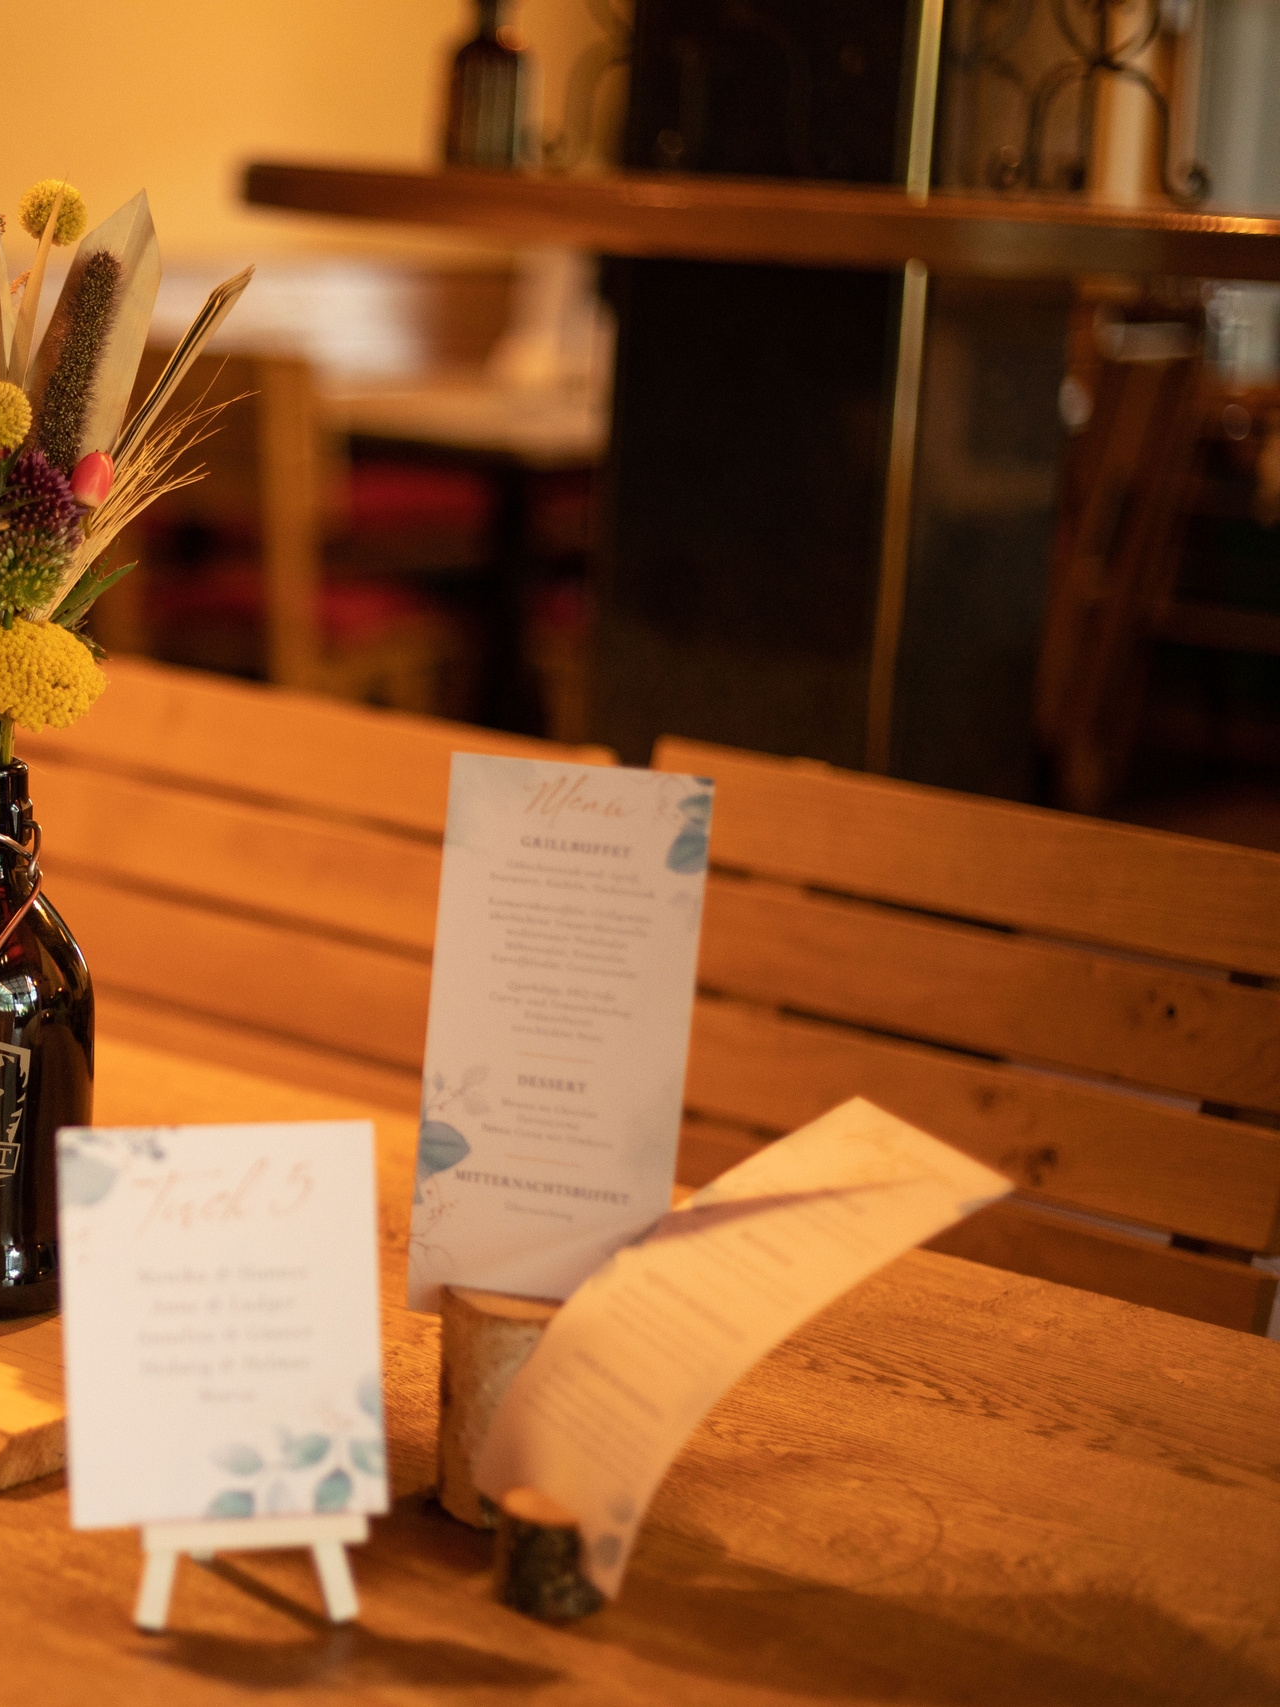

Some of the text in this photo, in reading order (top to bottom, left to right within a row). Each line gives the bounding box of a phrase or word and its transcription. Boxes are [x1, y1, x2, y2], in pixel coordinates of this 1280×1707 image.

[520, 835, 633, 860] GRILLBUFFET
[517, 1074, 587, 1094] DESSERT
[454, 1168, 631, 1206] MITTERNACHTSBUFFET
